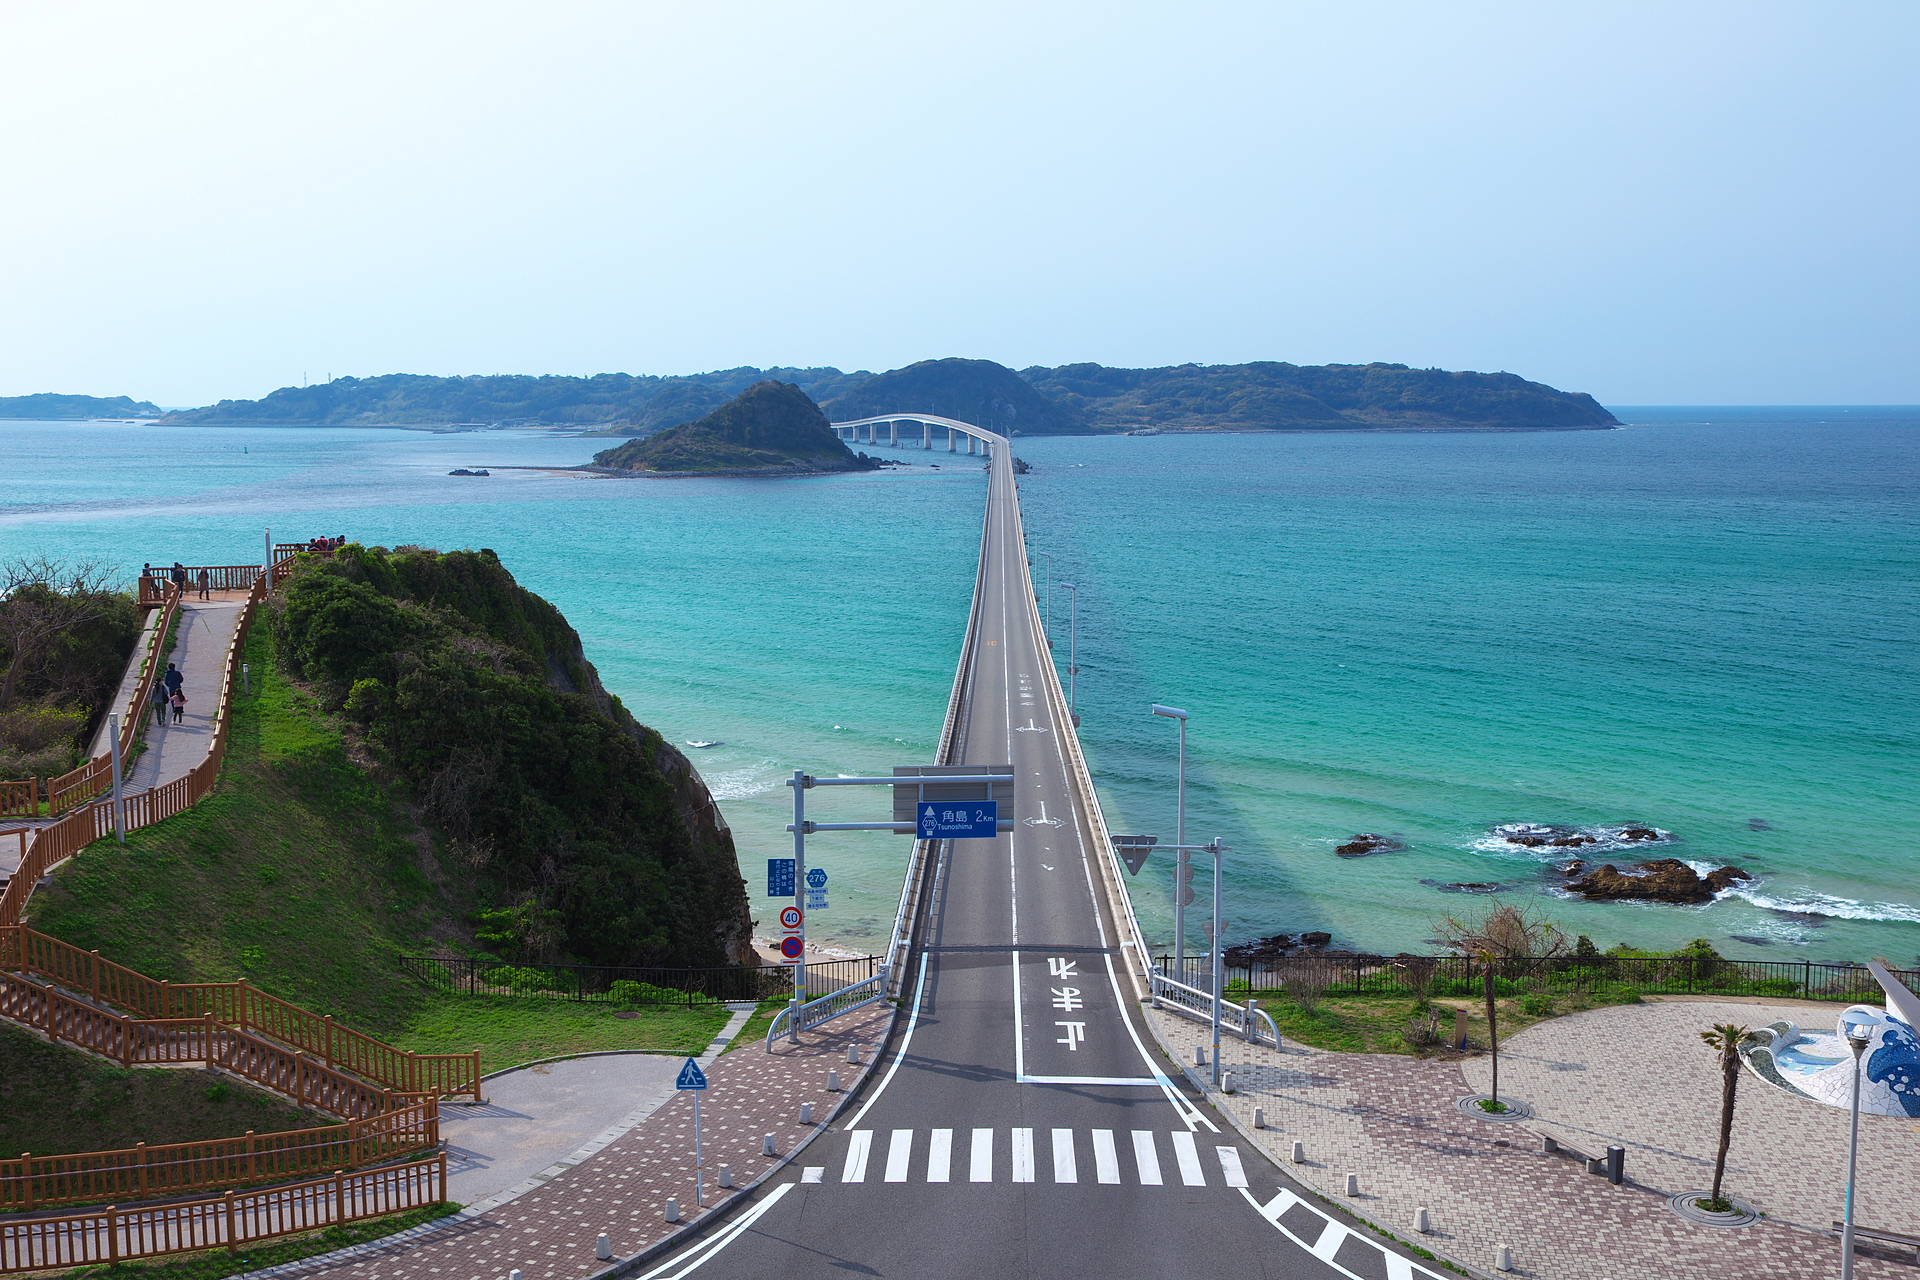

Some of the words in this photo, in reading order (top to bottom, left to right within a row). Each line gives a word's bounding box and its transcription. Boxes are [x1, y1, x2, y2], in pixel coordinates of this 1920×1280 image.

[942, 810, 968, 823] 角島
[809, 874, 825, 883] 276
[785, 913, 798, 922] 40
[1047, 957, 1086, 1051] 止まれ
